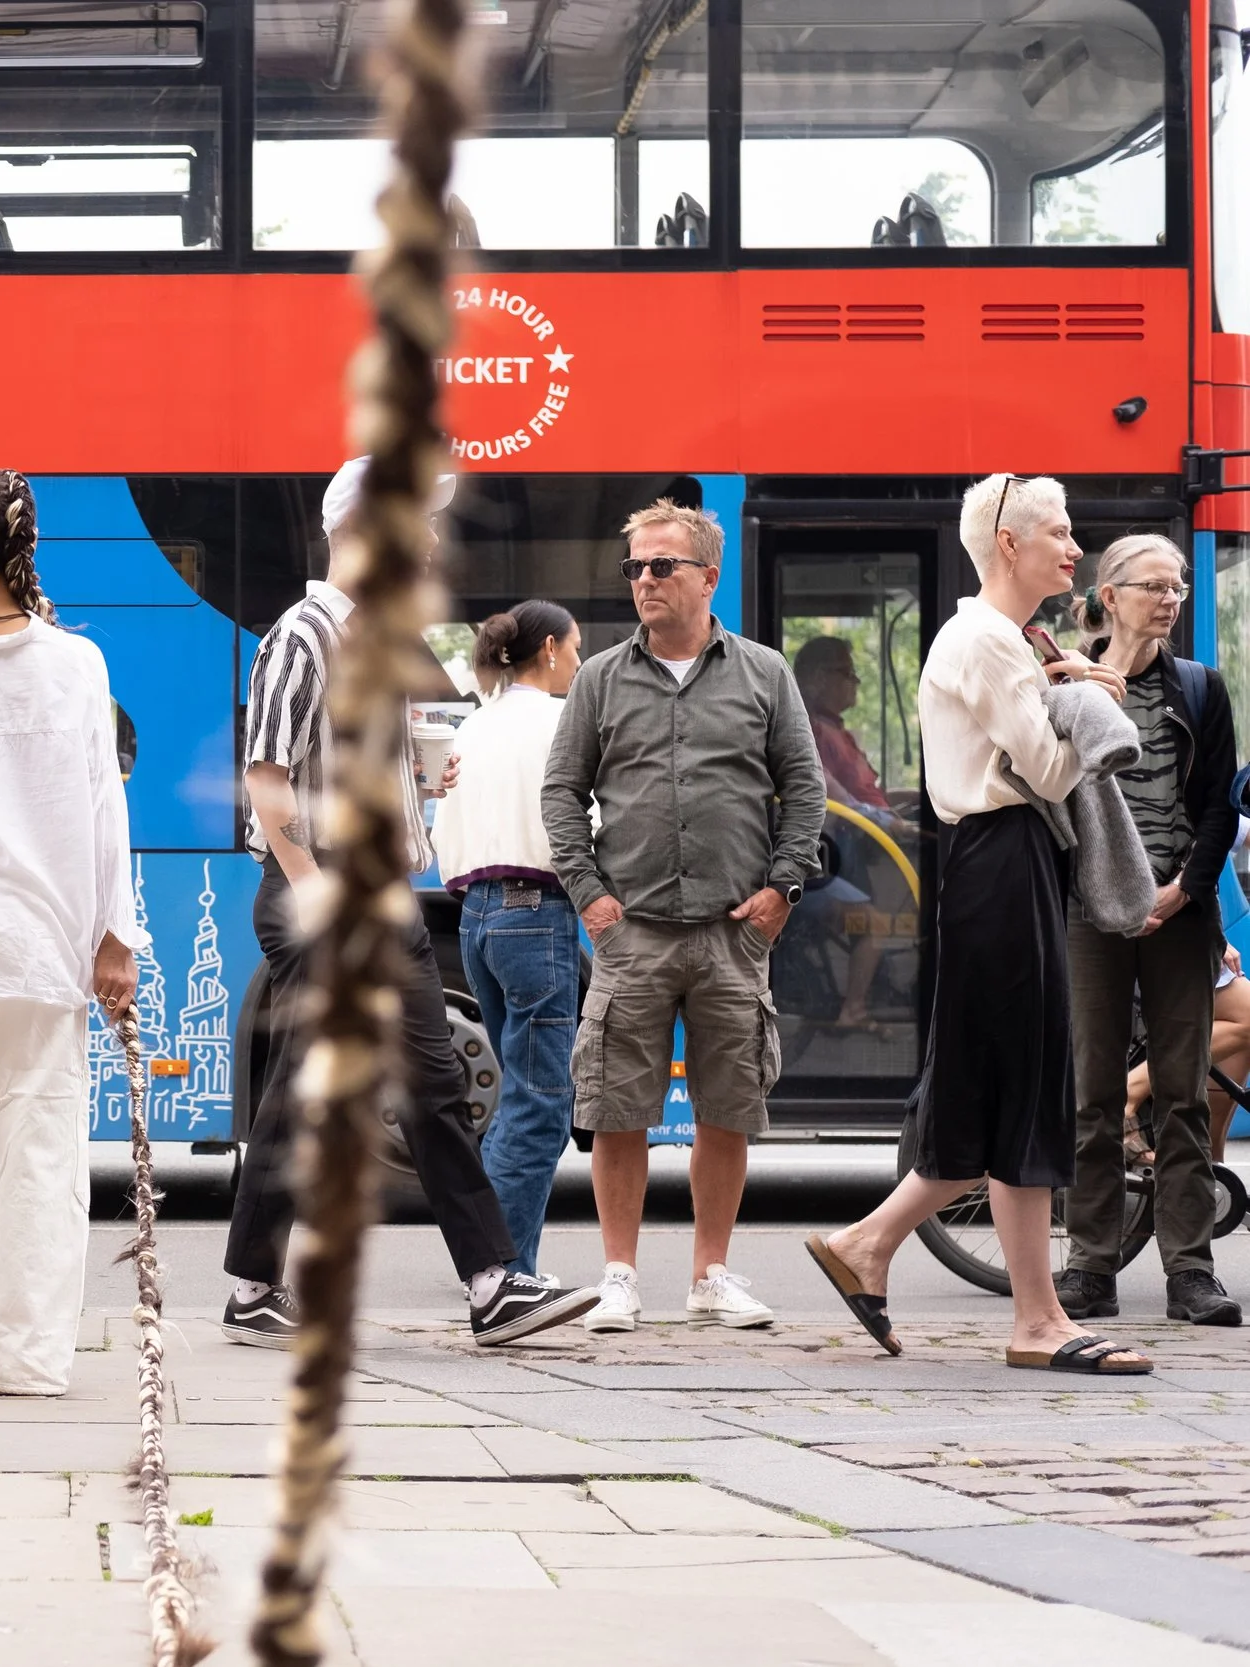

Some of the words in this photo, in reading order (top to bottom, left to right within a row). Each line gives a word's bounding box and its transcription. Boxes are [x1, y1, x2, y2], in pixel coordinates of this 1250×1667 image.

[454, 287, 483, 310] 24
[489, 288, 555, 341] HOUR
[450, 428, 533, 460] HOURS
[528, 382, 570, 436] FREE
